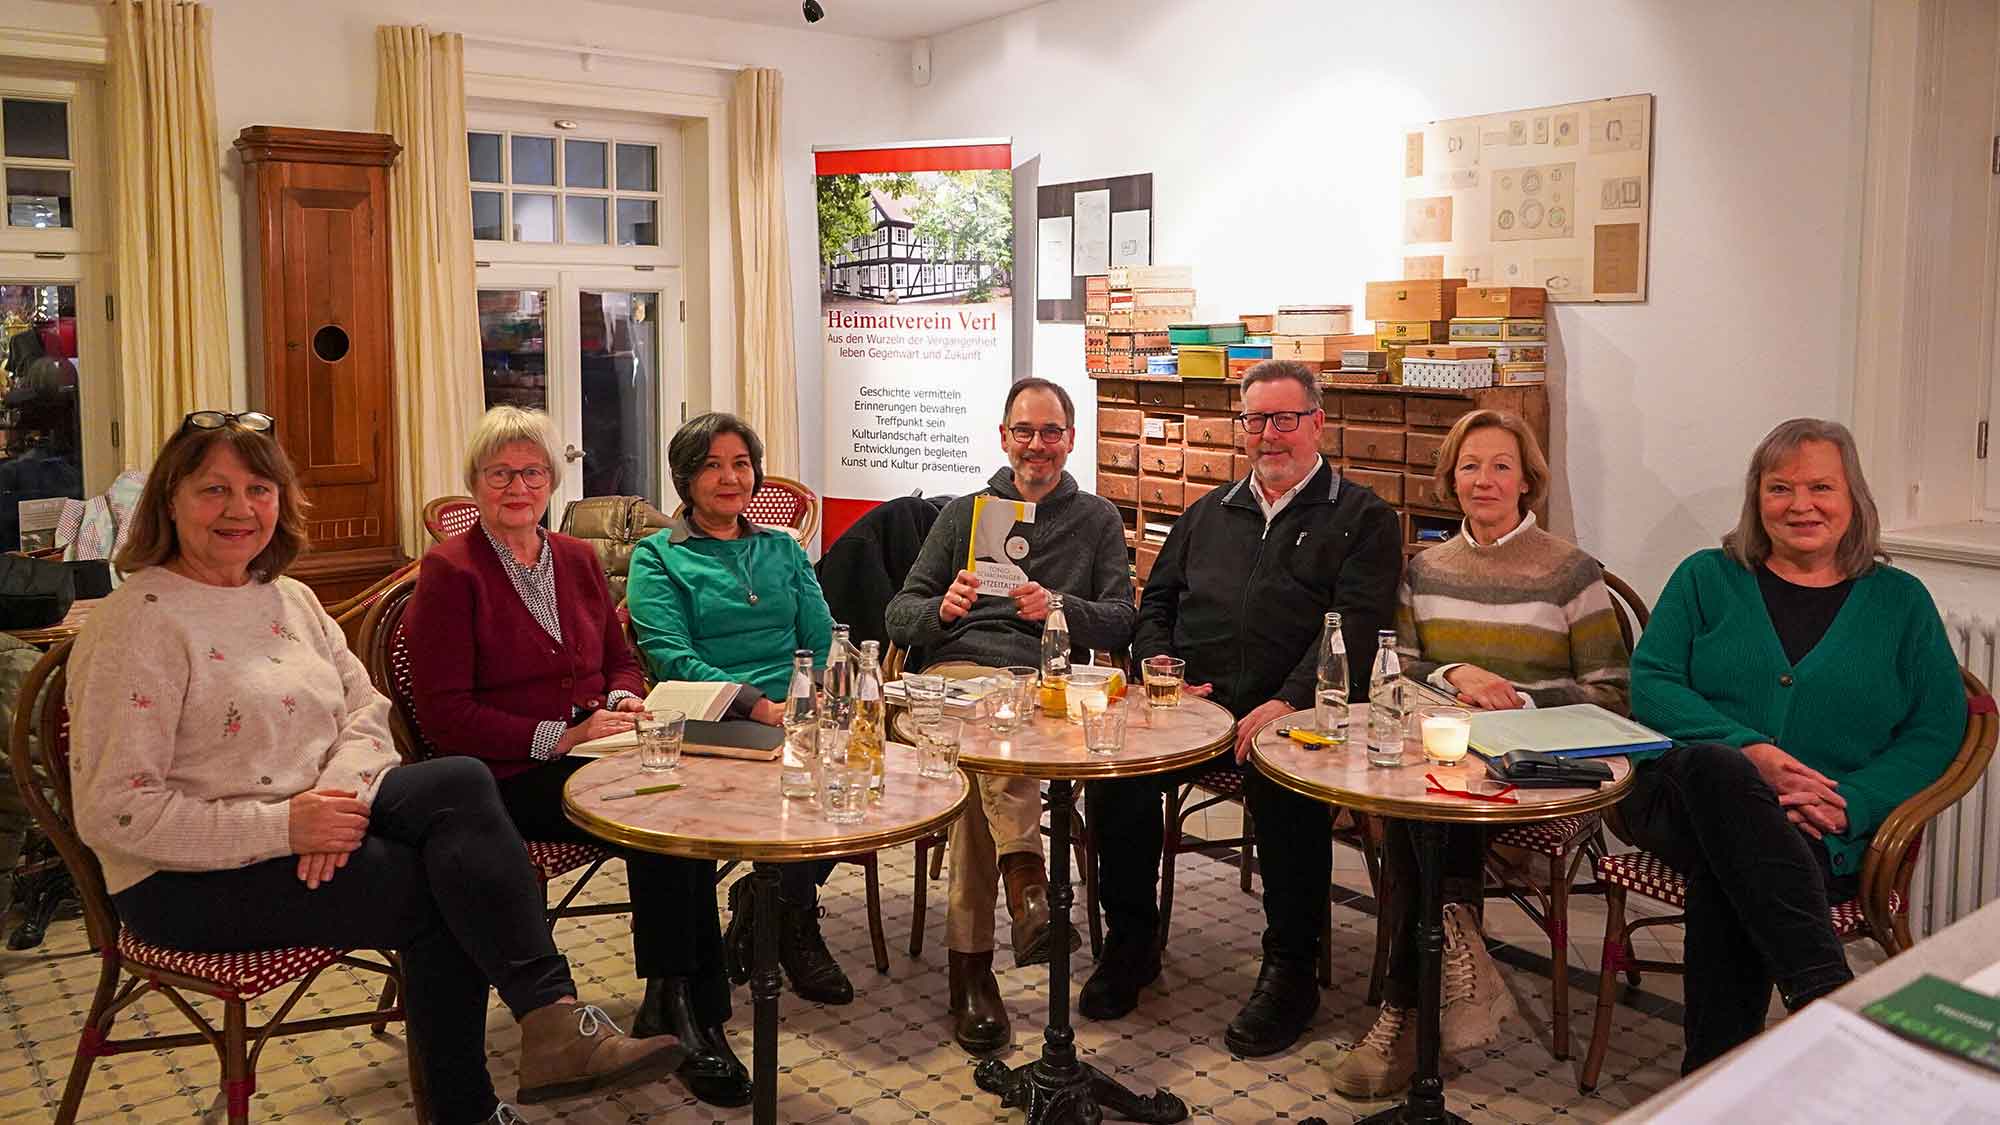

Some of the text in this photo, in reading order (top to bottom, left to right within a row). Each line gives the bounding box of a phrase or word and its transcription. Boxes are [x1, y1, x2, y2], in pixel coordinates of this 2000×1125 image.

[828, 310, 997, 331] Heimatverein Verl
[827, 333, 997, 348] Aus den Wurzeln der Vergangenheit
[839, 347, 981, 361] leben Gegenwart und Zukunft
[859, 386, 961, 400] Geschichte vermitteln
[854, 400, 967, 415] Erinnerungen bewahren
[875, 415, 946, 428] Treffpunkt sein
[852, 429, 969, 444] Kulturlandschaft erhalten
[854, 443, 968, 460] Entwicklungen begleiten
[841, 456, 867, 468] Kunst
[870, 457, 888, 469] und
[891, 459, 919, 470] Kultur
